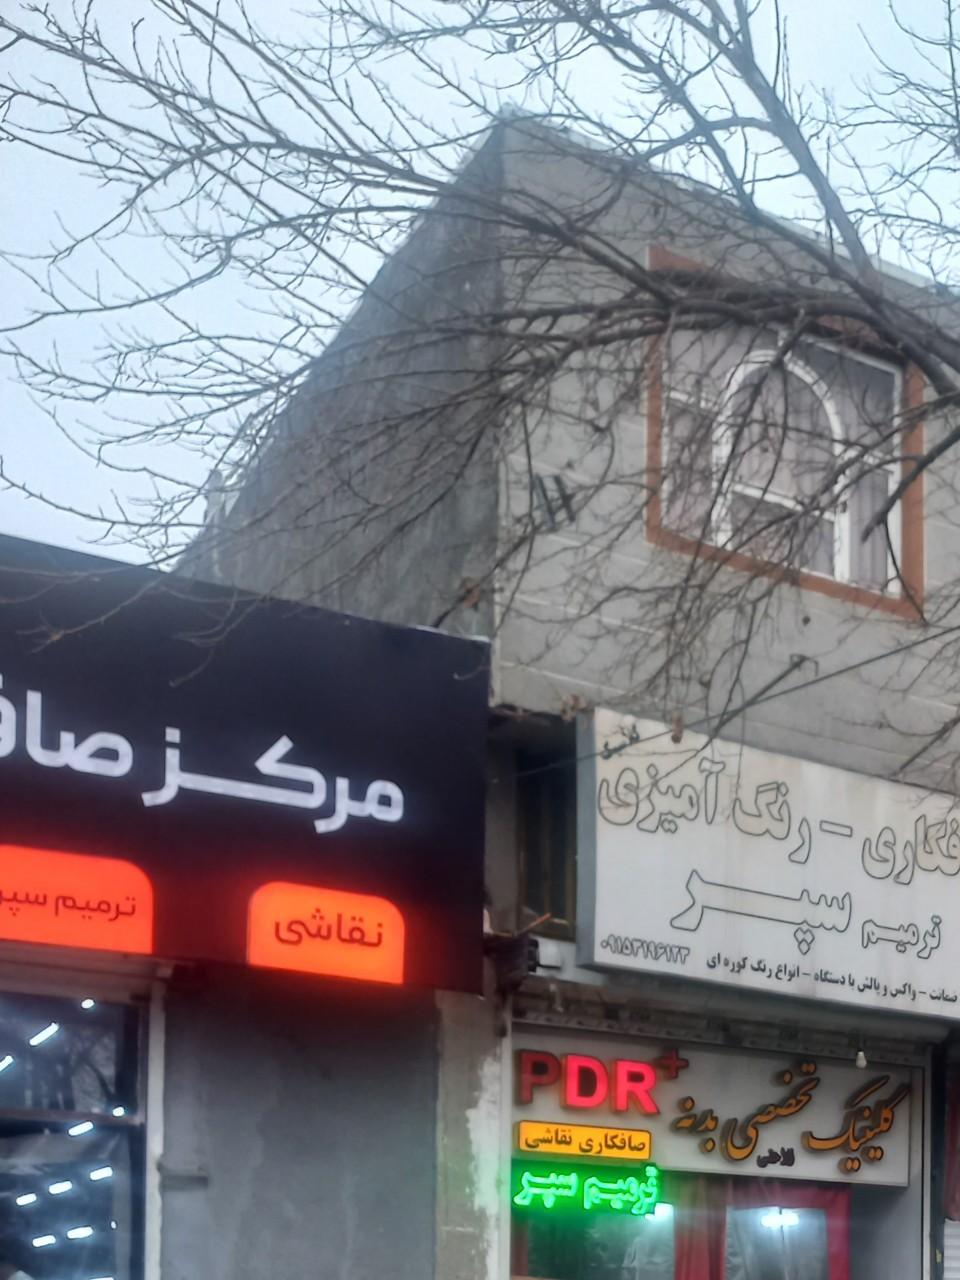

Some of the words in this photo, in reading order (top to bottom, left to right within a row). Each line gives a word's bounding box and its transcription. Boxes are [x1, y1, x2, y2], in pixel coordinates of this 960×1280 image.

[140, 726, 405, 835] مرکز
[599, 757, 725, 833] آمیزی
[733, 781, 811, 865] رنگ
[0, 888, 48, 918] سپ
[54, 894, 137, 922] ترمیم
[670, 869, 852, 956] سپر
[273, 907, 385, 949] نقاشی
[862, 915, 942, 960] ترمیم
[814, 969, 845, 986] دستگاه
[722, 1059, 821, 1161] تخصصی
[803, 1075, 912, 1173] کلینیک
[525, 1128, 572, 1149] نقاشی
[579, 1132, 646, 1154] صافکاری
[513, 1171, 578, 1208] سپر
[583, 1165, 658, 1215] ترمیم
